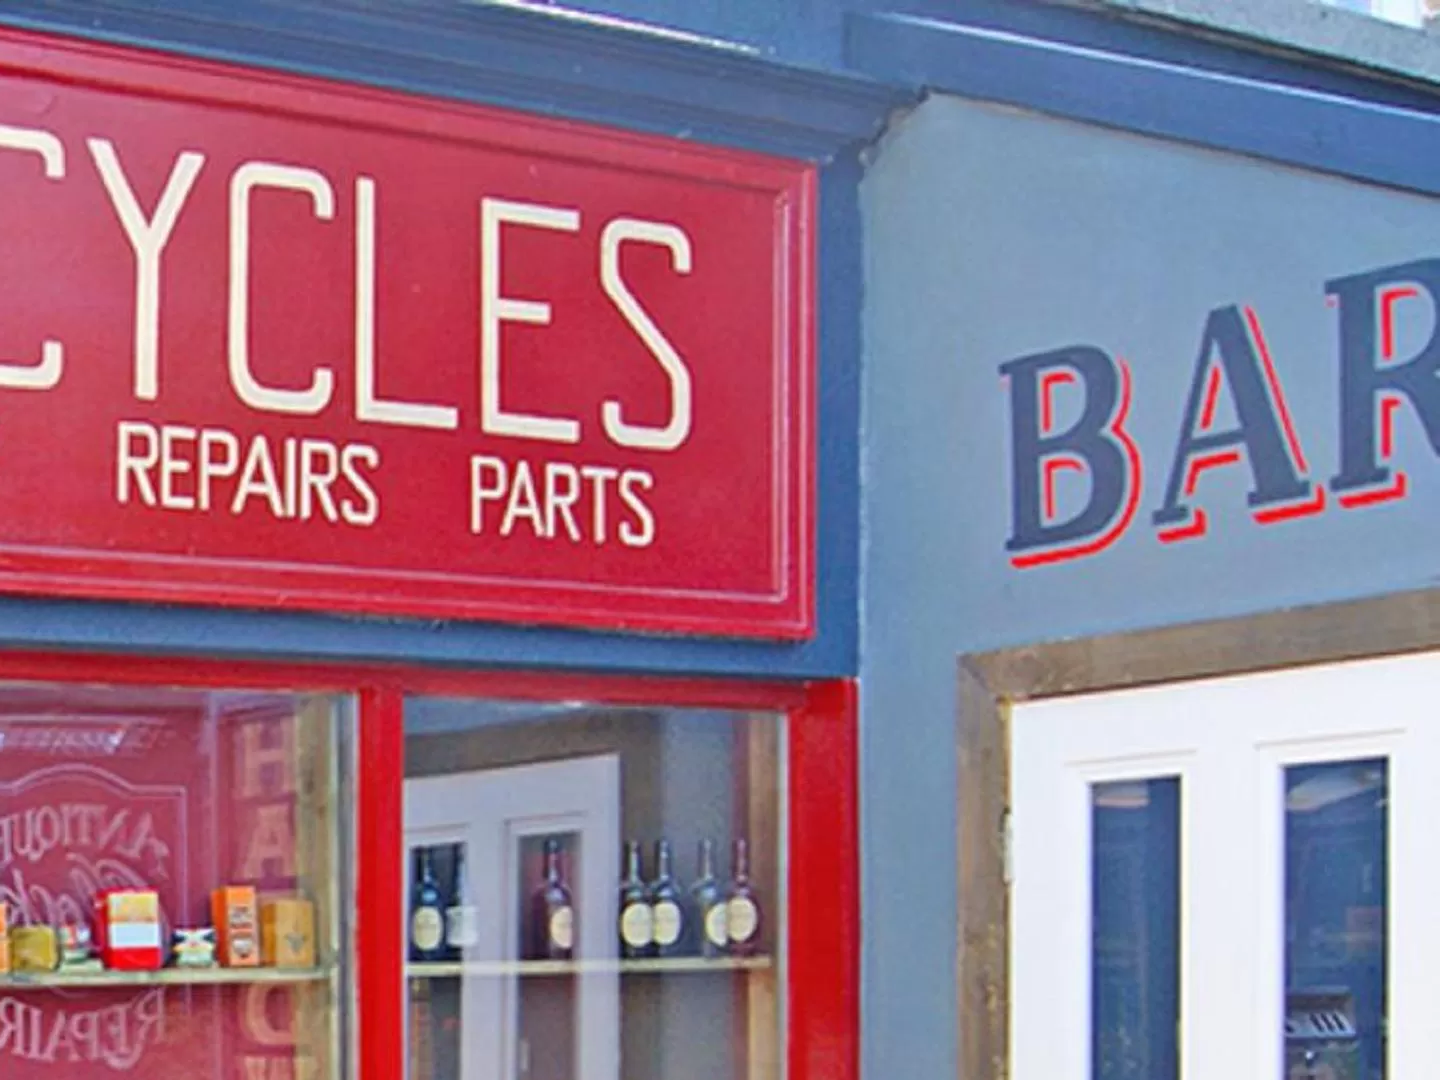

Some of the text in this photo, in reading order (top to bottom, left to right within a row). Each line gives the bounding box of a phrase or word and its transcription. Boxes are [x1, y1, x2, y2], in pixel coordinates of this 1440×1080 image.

[117, 421, 380, 527] REPAIRS
[470, 454, 656, 548] PARTS
[998, 257, 1440, 569] BAR
